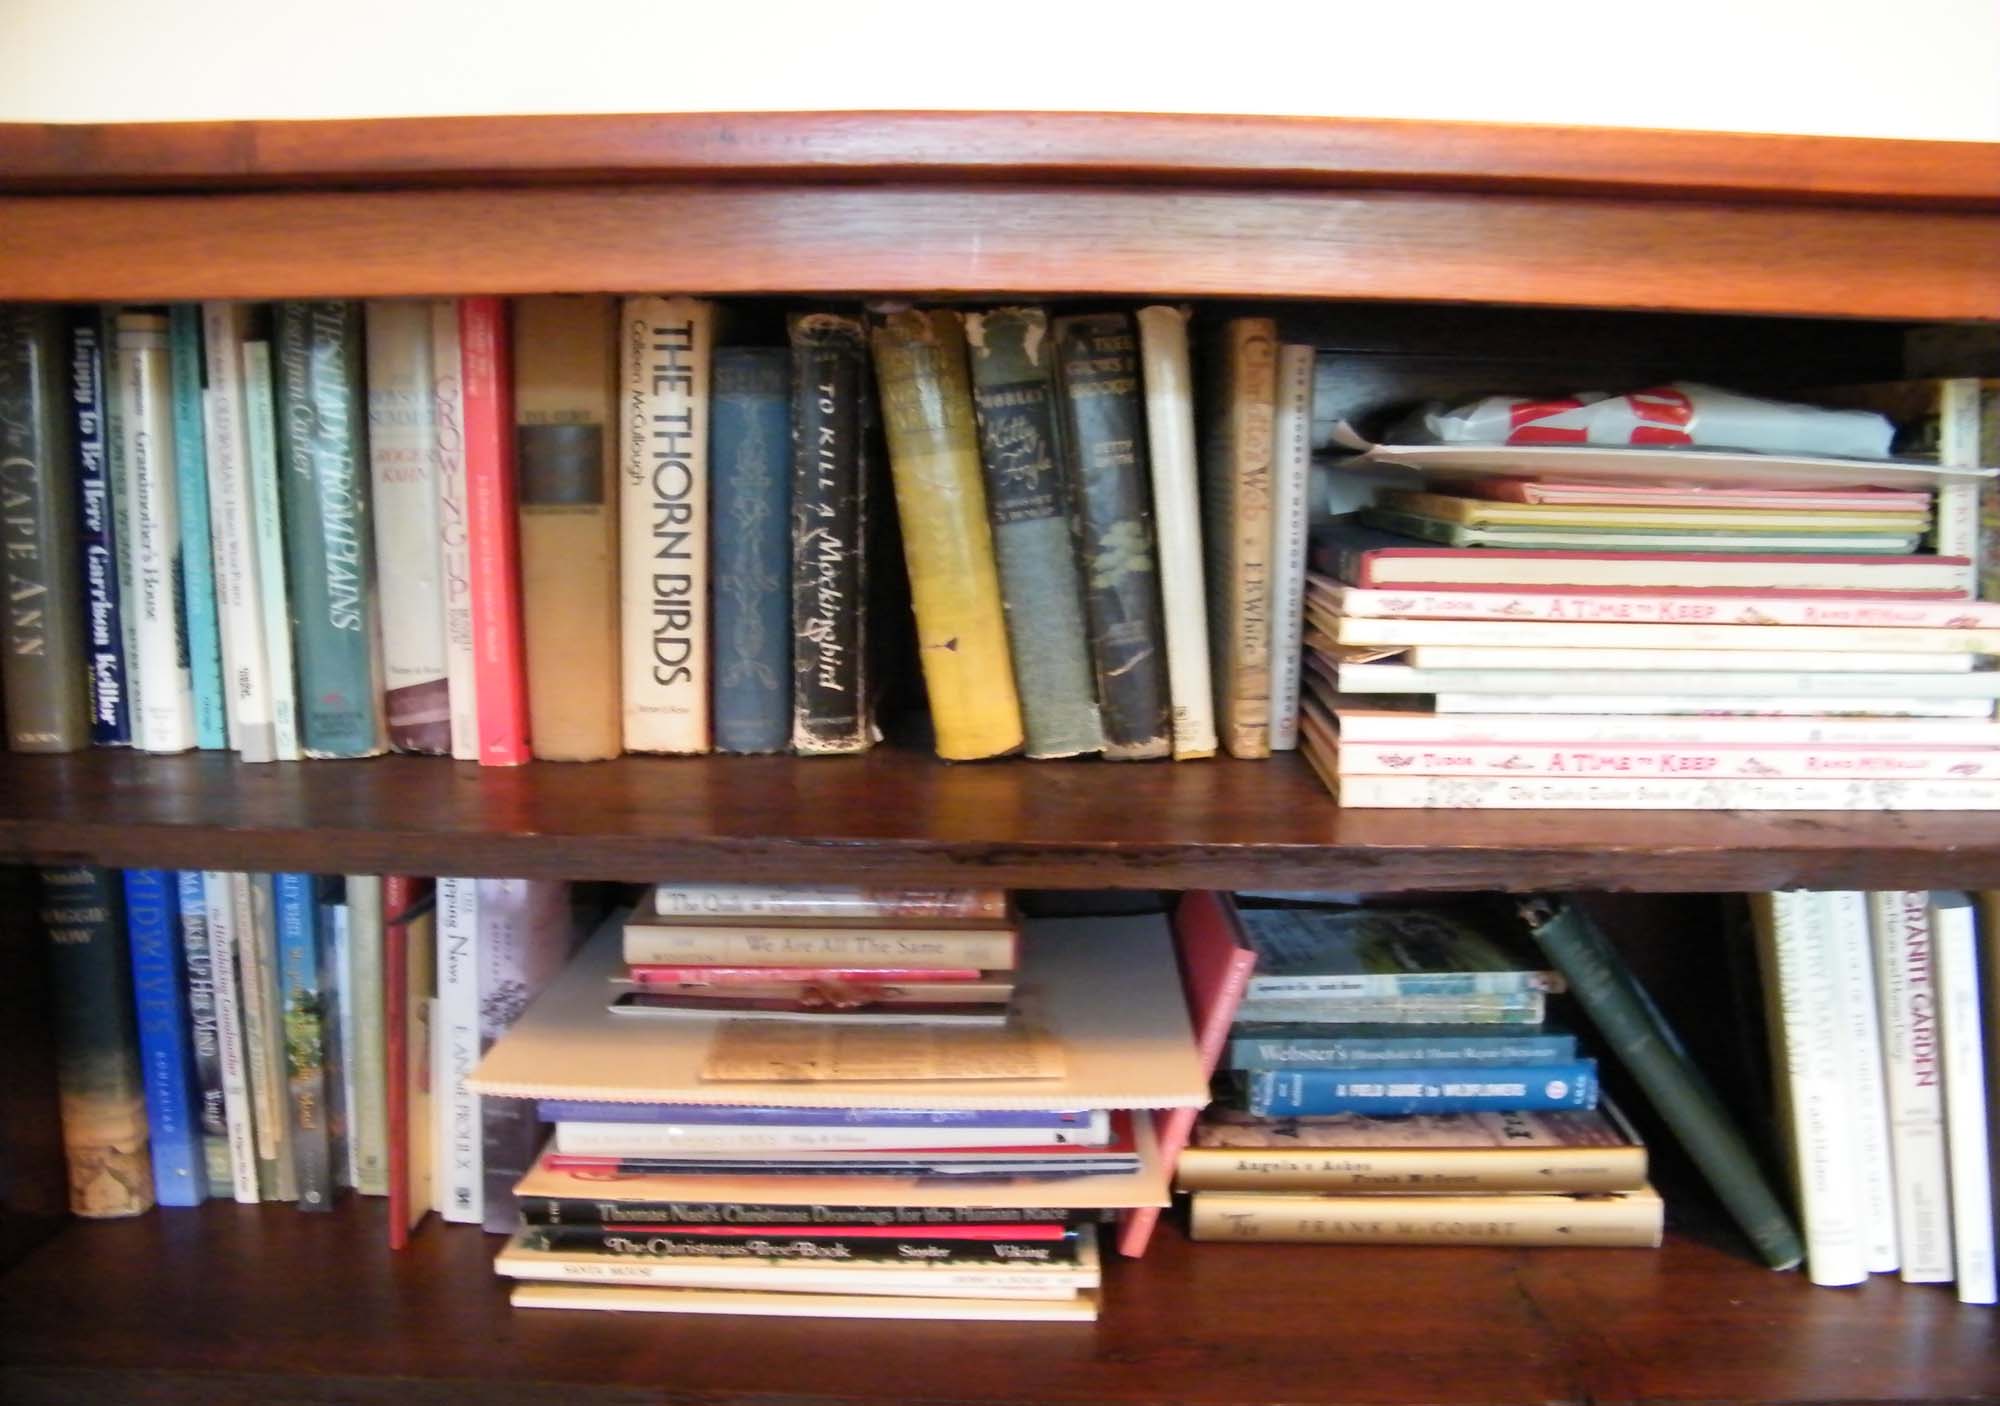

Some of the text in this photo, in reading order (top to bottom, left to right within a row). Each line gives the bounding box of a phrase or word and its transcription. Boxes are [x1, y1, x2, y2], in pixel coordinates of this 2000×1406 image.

[624, 320, 649, 486] Colleen McCullough
[652, 320, 695, 396] THE
[818, 384, 835, 414] TO
[321, 450, 357, 541] FROM
[652, 406, 695, 560] THORN
[818, 427, 836, 492] KILL
[1240, 463, 1272, 523] Web
[2, 457, 41, 560] CAPE
[4, 575, 48, 657] ANN
[327, 542, 361, 633] PLAINS
[650, 573, 693, 687] BIRDS
[812, 533, 844, 693] Mockingbird
[1549, 598, 1568, 620] A
[1548, 753, 1568, 772] A
[443, 878, 470, 985] ipping News
[1910, 992, 1939, 1088] GARDEN
